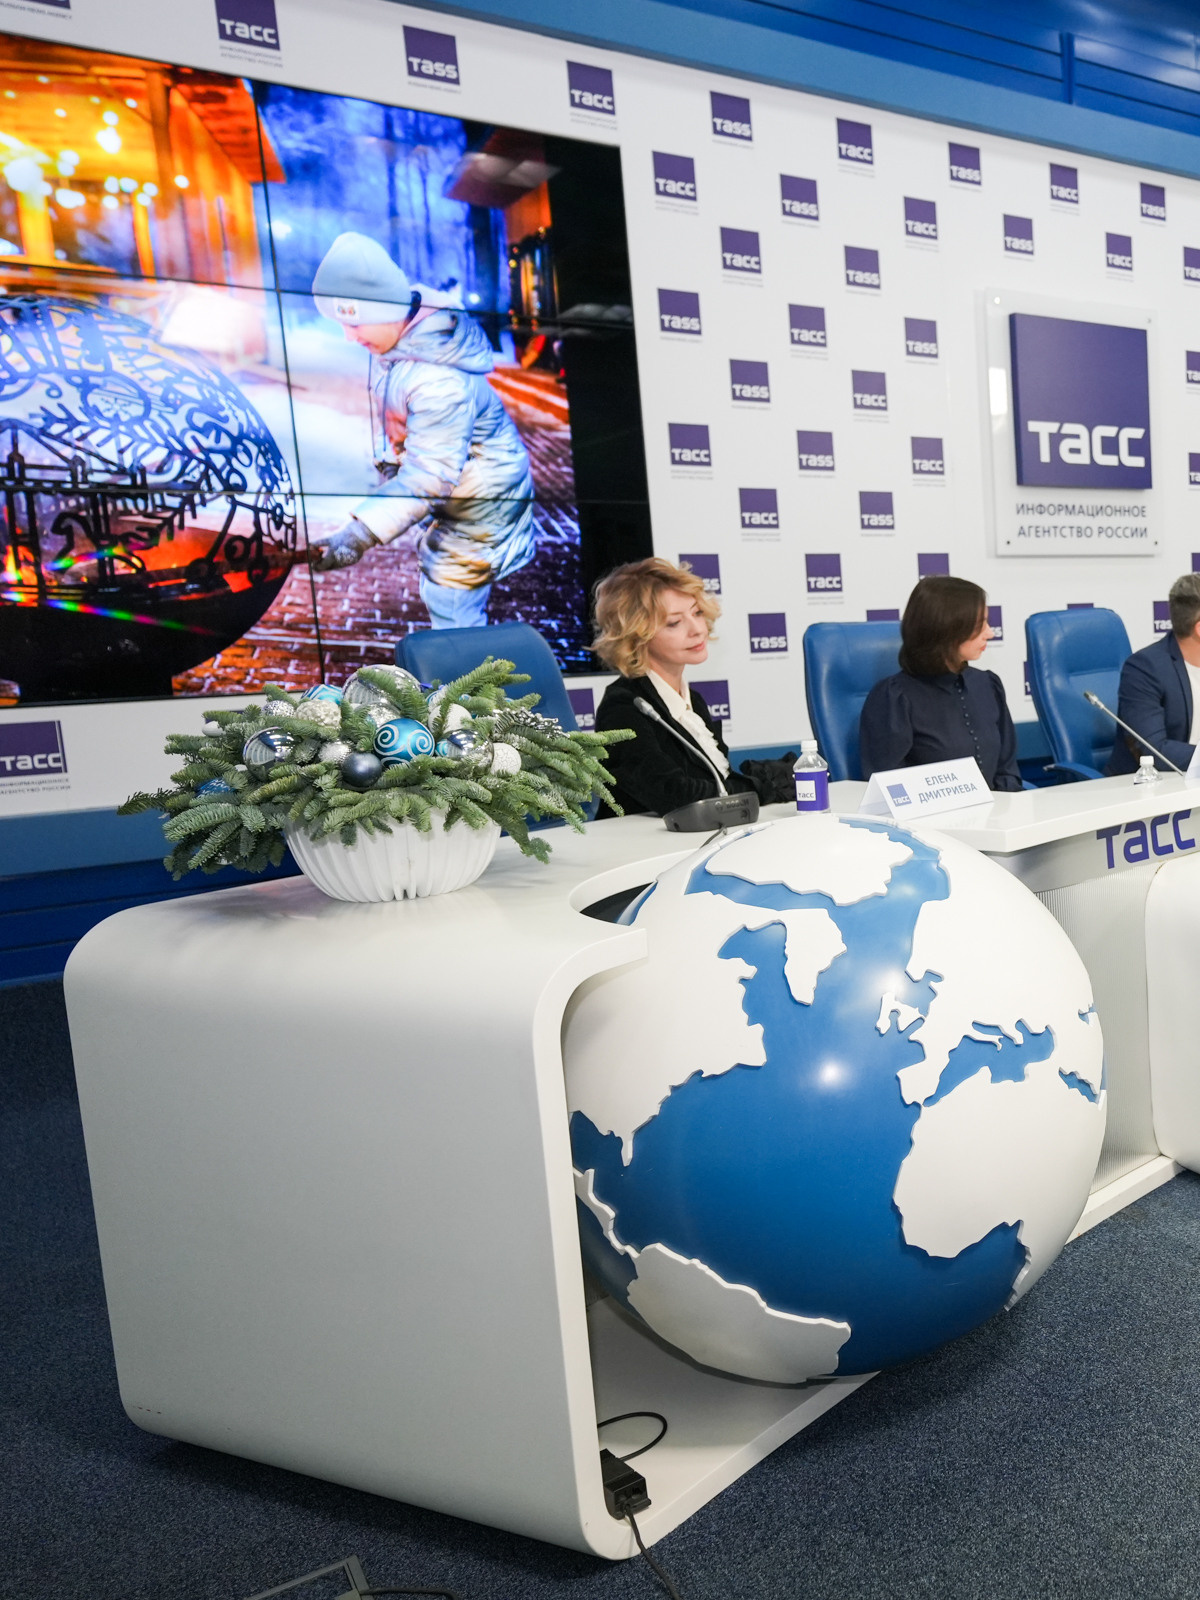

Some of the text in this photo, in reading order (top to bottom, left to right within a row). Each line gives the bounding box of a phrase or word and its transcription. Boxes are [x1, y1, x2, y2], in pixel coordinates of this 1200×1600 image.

[1016, 503, 1146, 518] ИНФОРМАЦИОННОЕ
[1017, 525, 1147, 538] АГЕНТСТВО РОССИИ
[925, 773, 958, 786] ЕЛЕНА
[919, 783, 977, 804] ДМИТРИЕВА
